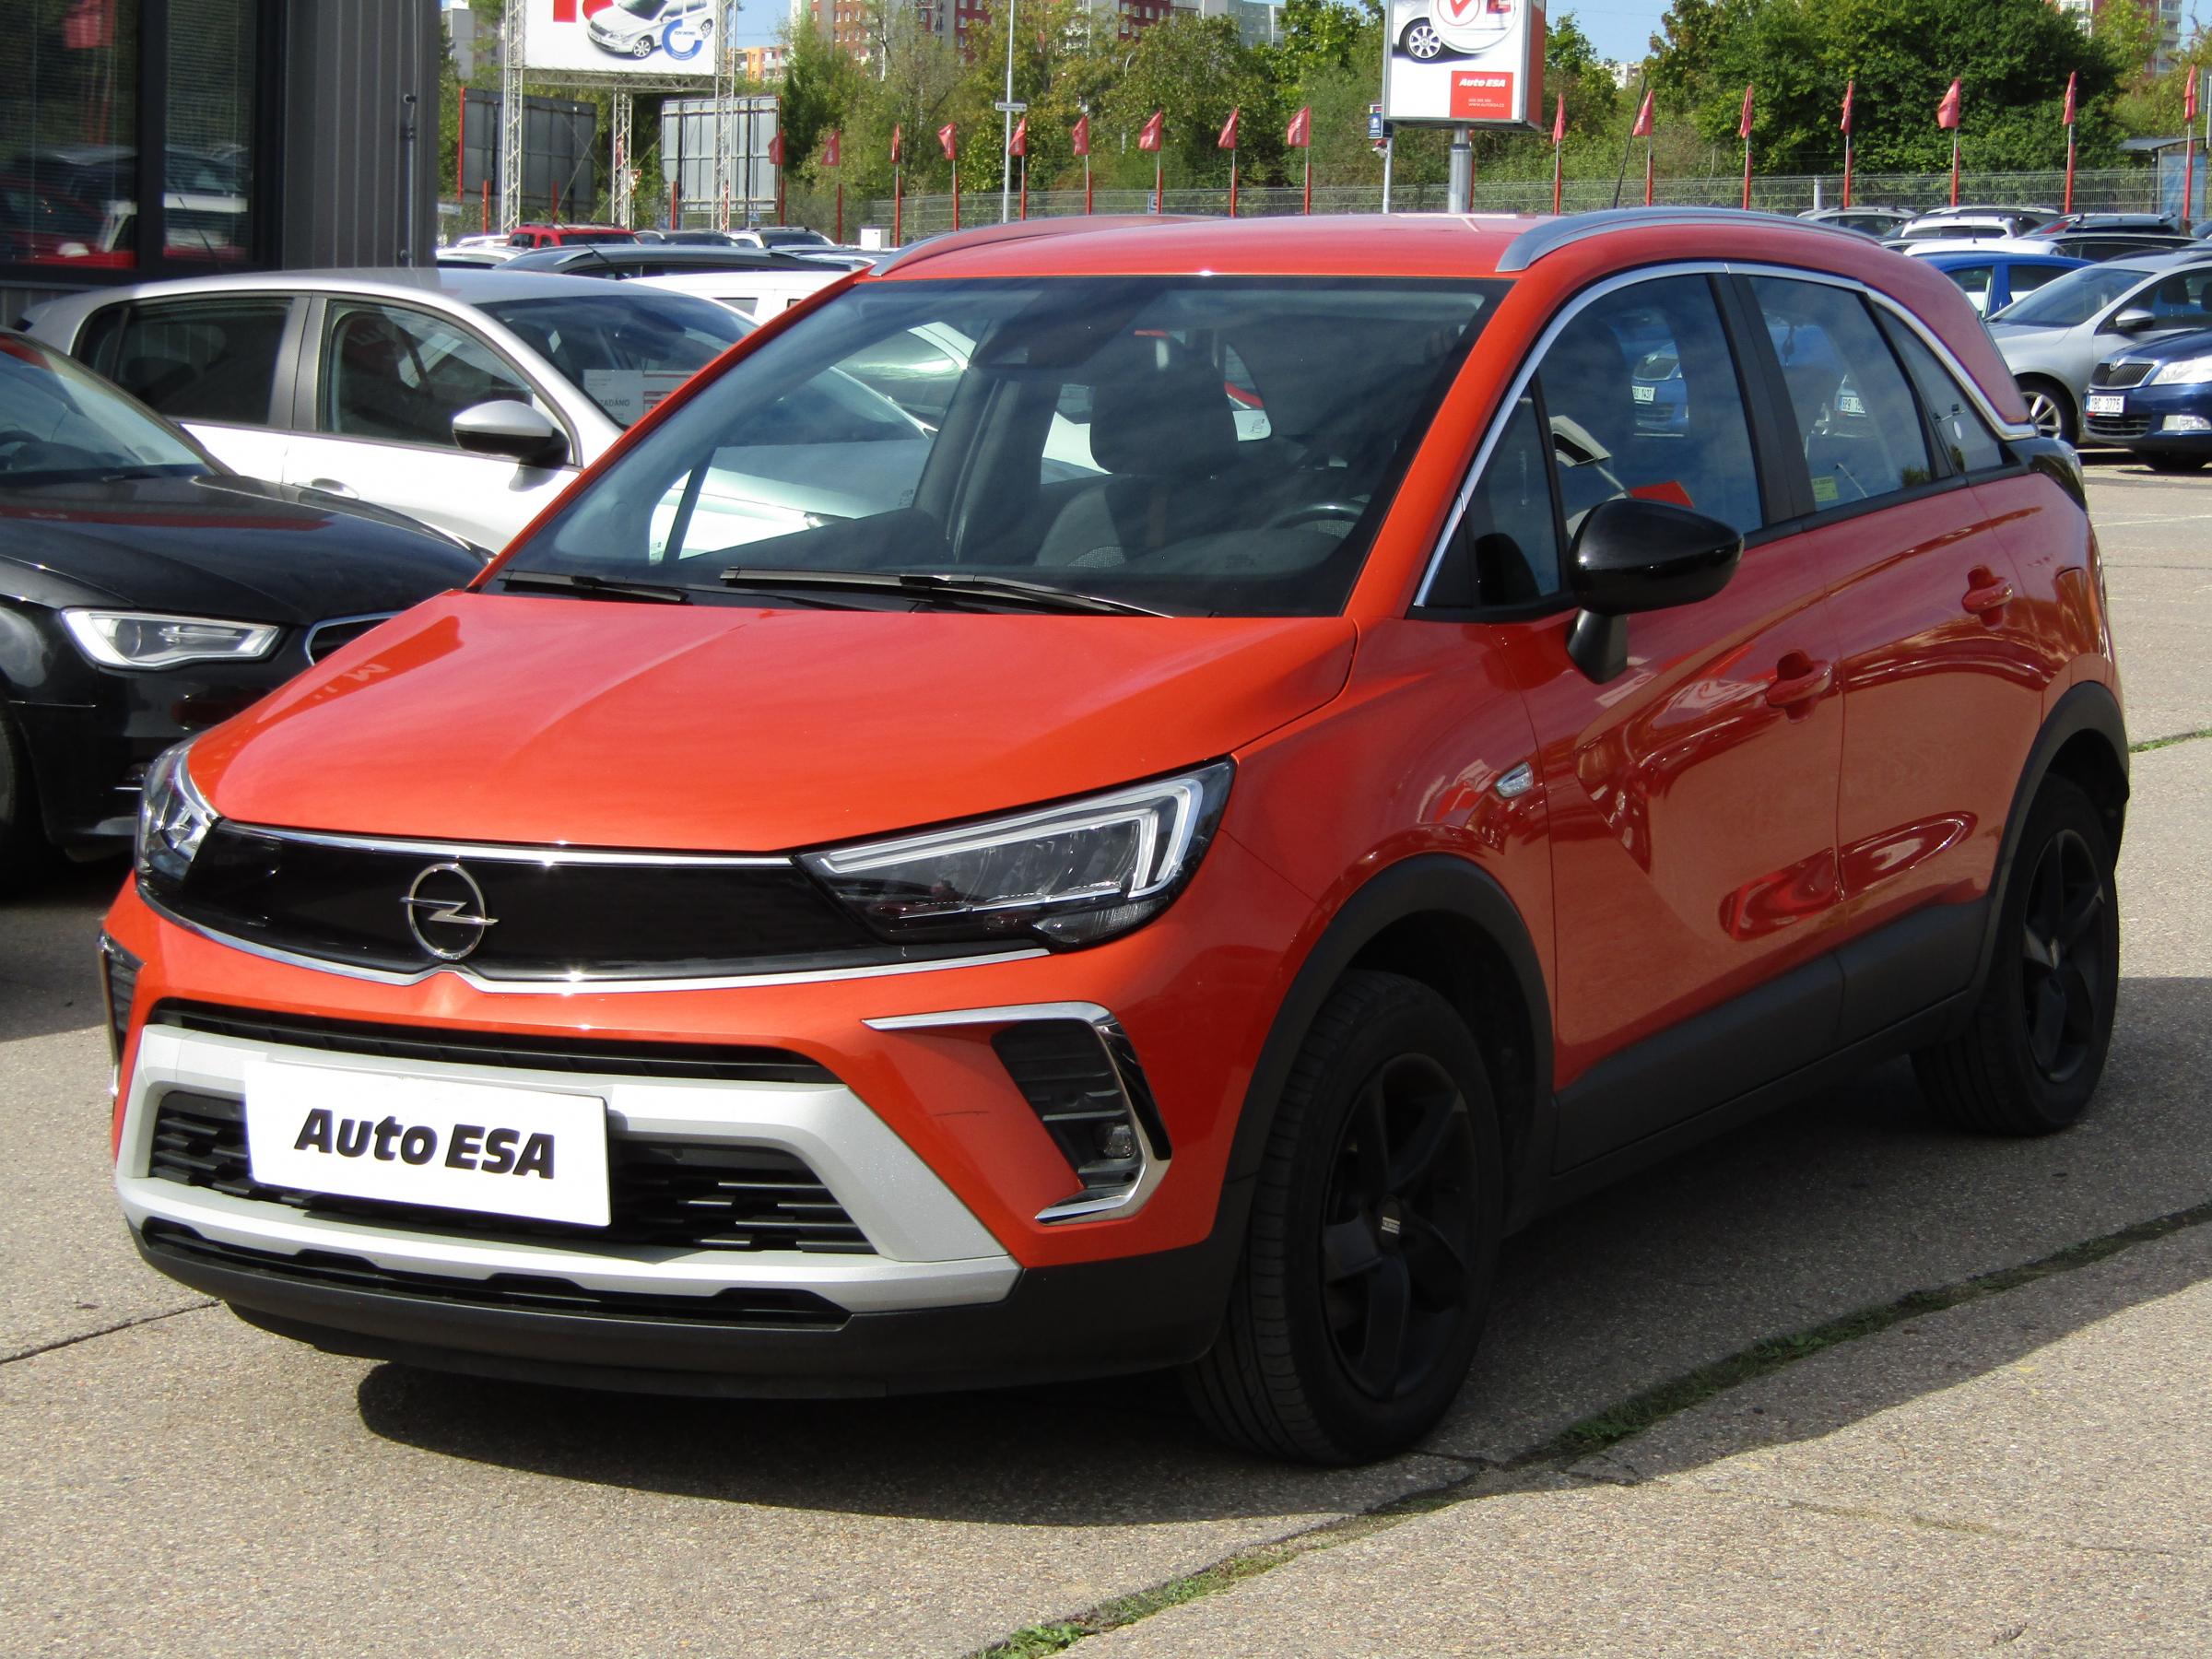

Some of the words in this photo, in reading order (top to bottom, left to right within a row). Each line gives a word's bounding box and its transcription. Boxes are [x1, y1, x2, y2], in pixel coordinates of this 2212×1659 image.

[1458, 78, 1485, 88] Auto
[1486, 79, 1506, 88] ESA
[294, 1108, 438, 1165] Auto
[445, 1124, 555, 1179] ESA
